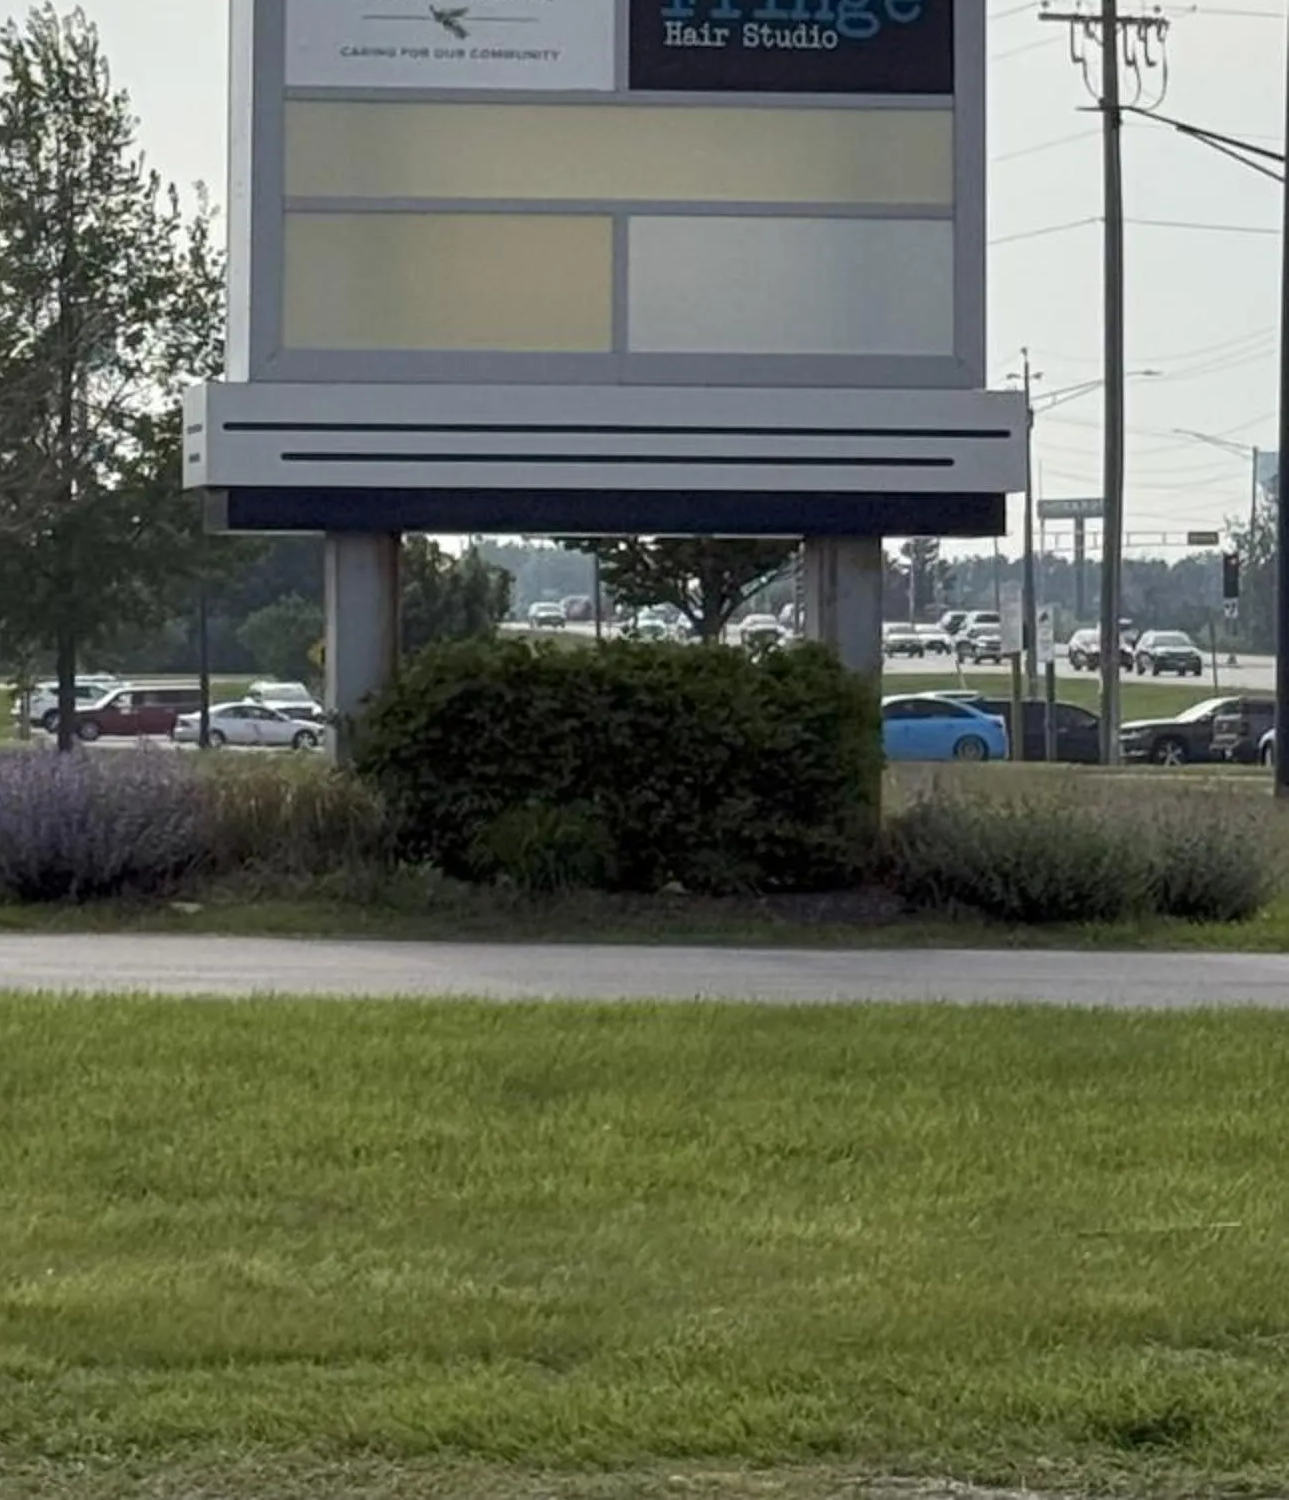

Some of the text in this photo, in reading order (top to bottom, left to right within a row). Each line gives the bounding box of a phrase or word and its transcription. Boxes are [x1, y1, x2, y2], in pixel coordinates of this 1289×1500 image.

[663, 21, 839, 50] Hair Studio
[401, 47, 430, 59] FOR
[434, 48, 465, 60] OUR
